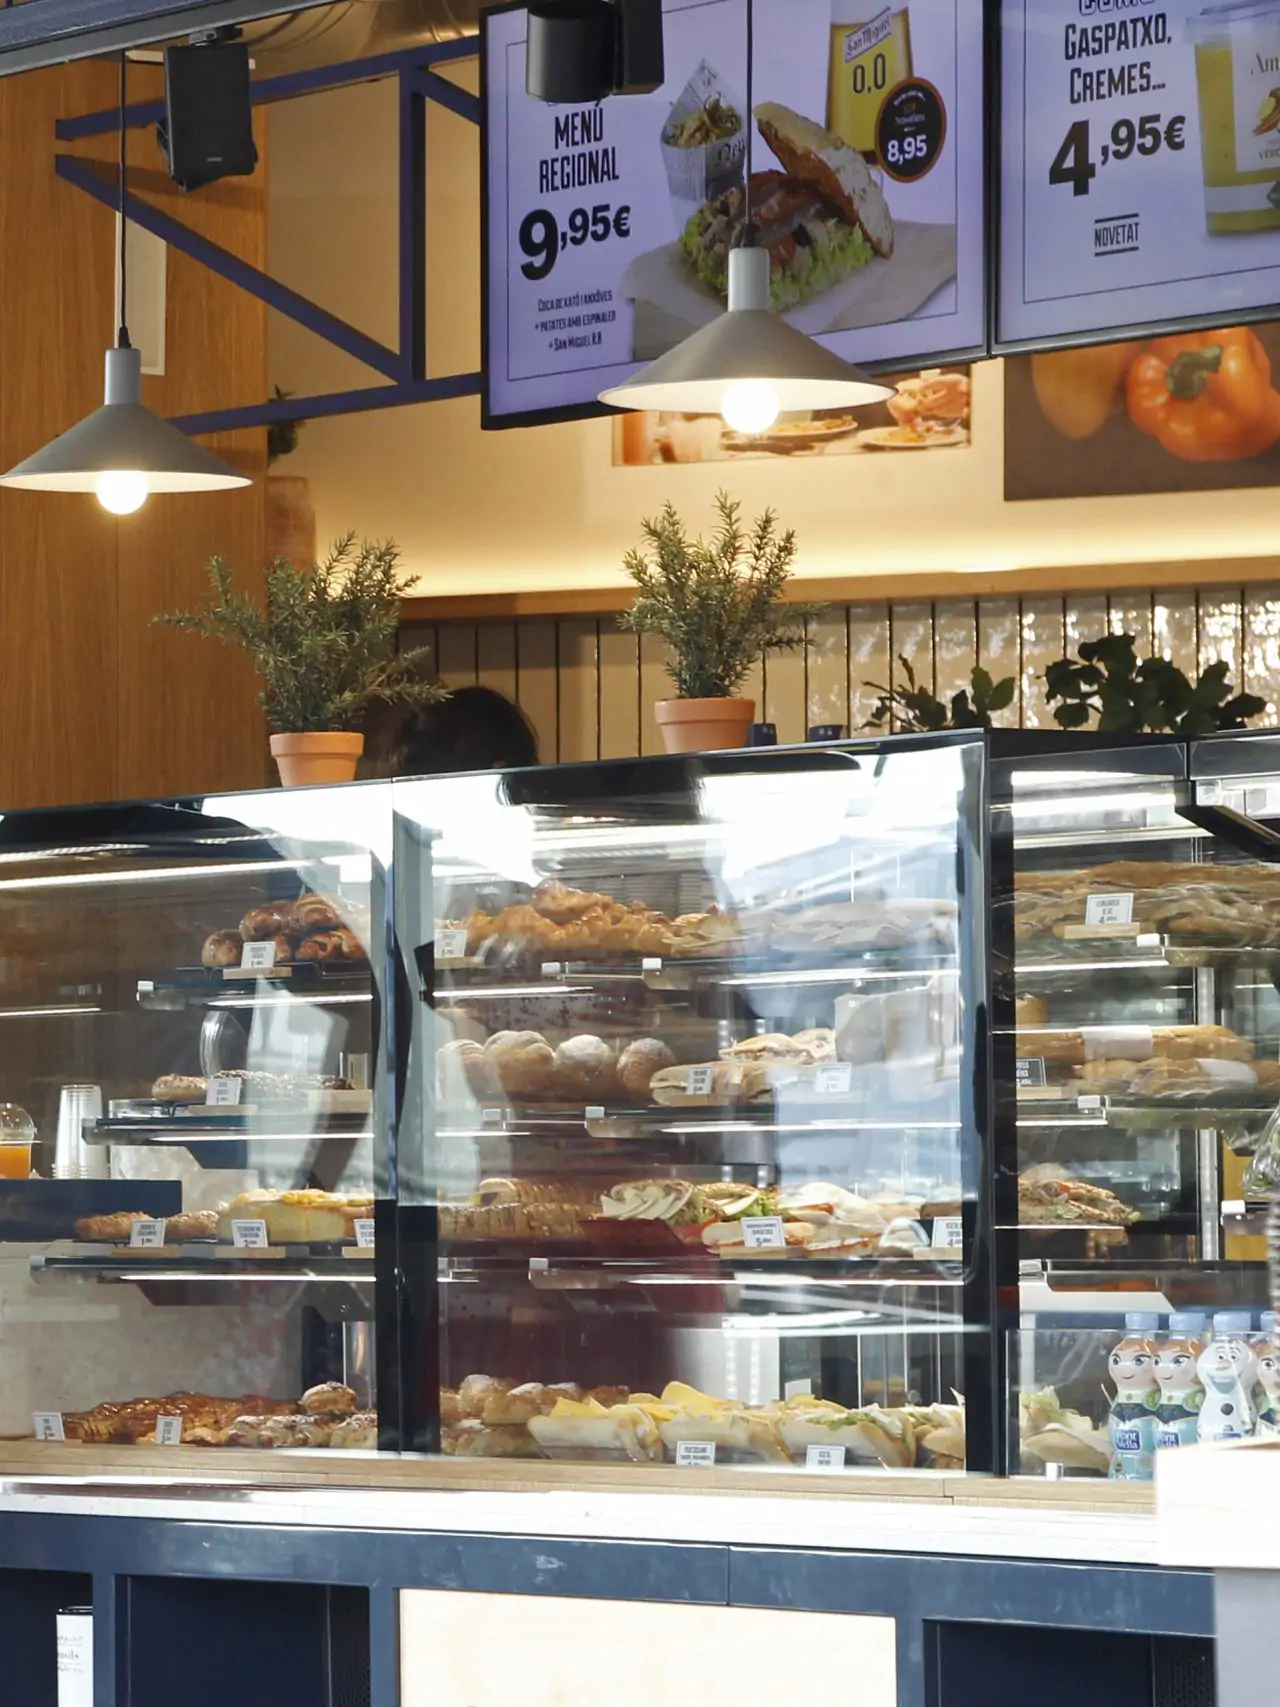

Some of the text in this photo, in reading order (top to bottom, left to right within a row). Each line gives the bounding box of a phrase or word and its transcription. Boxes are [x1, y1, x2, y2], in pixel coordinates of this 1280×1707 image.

[1065, 12, 1172, 60] GASPATXO,
[853, 53, 886, 94] 0,0
[555, 101, 603, 150] MENÚ
[540, 147, 619, 194] REGIONAL
[887, 134, 927, 165] 8,95
[1049, 114, 1187, 197] 4,95€
[519, 204, 631, 281] 9,95€
[1095, 222, 1140, 248] NOVETAT
[540, 317, 566, 332] PATATES
[554, 337, 567, 351] SAN
